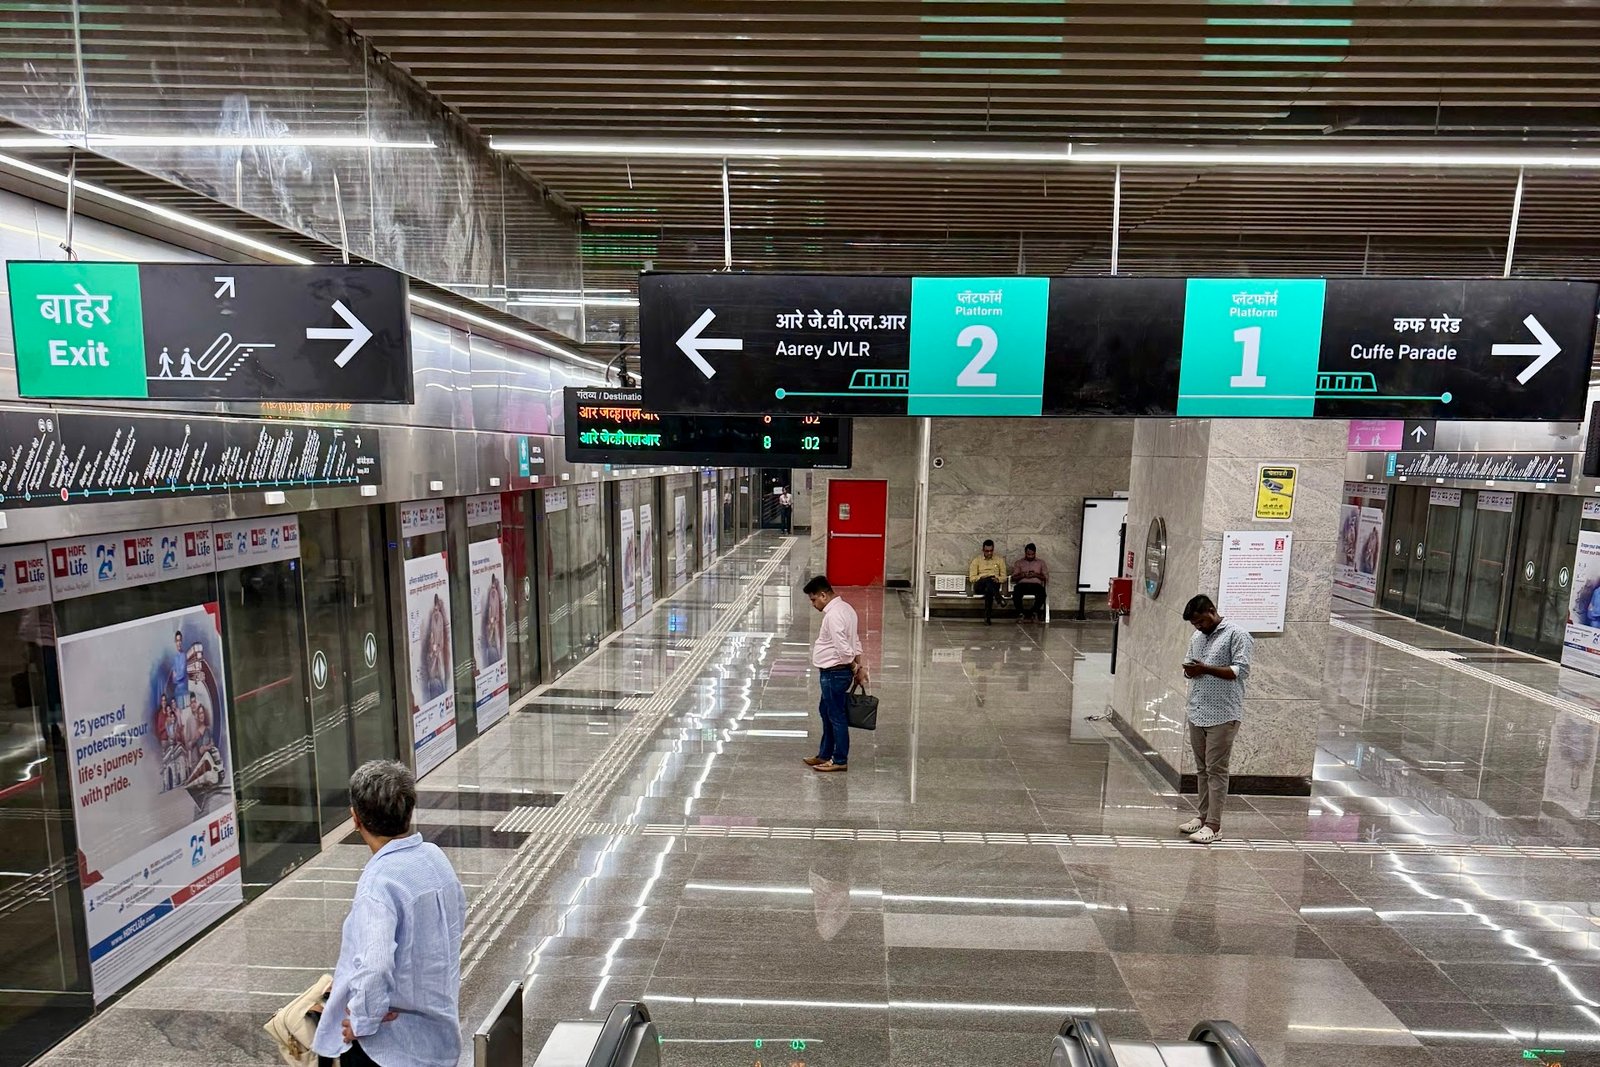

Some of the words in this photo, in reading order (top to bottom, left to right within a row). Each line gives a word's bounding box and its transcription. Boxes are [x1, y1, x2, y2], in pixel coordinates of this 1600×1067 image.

[36, 283, 112, 328] बाहेर
[957, 289, 1002, 304] प्लॅटफॉर्म
[1231, 289, 1279, 306] प्लॅटफॉर्म
[775, 308, 804, 329] आरे
[807, 308, 907, 332] जे.वी.एल.आर
[955, 306, 1003, 316] Platform
[1229, 307, 1278, 317] Platform
[1393, 318, 1426, 333] कफ
[1429, 313, 1462, 333] परेड
[48, 339, 110, 367] Exit
[775, 341, 823, 360] Aarey
[827, 341, 871, 357] JVLR
[956, 324, 998, 387] 2
[1230, 326, 1266, 387] 1
[1350, 344, 1394, 360] Cuffe
[1398, 344, 1457, 360] Parade
[603, 391, 642, 401] Destinatio
[580, 428, 599, 445] आरे
[763, 435, 772, 449] 8
[137, 536, 154, 548] HDFC
[195, 529, 210, 541] HDFC
[68, 544, 86, 557] HDFC
[138, 549, 155, 566] Life
[196, 540, 212, 557] Life
[29, 568, 45, 582] Life
[69, 558, 89, 576] Life
[73, 719, 86, 737] 25
[87, 712, 115, 737] years
[116, 704, 126, 720] of
[76, 731, 127, 766] protecting
[127, 722, 149, 745] your
[103, 748, 144, 779] journeys
[80, 786, 103, 808] with
[104, 776, 131, 803] pride.
[220, 823, 234, 841] Life
